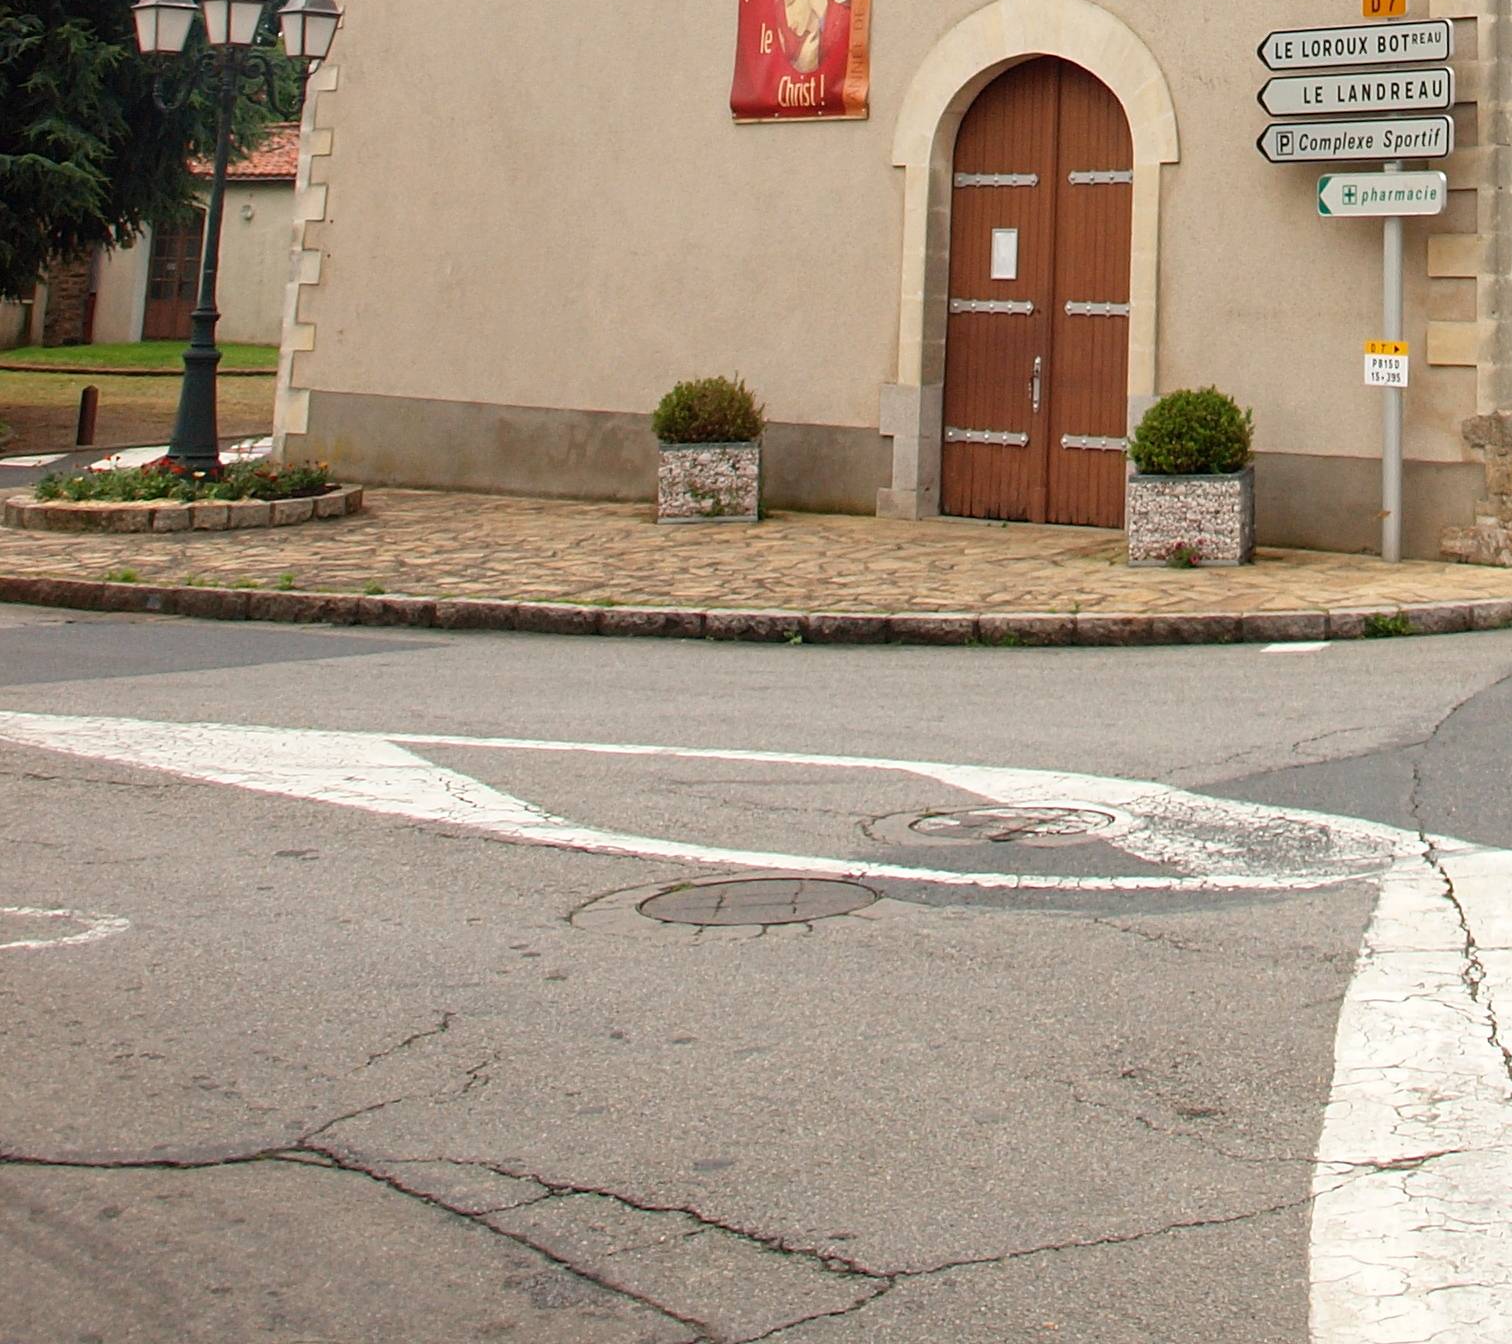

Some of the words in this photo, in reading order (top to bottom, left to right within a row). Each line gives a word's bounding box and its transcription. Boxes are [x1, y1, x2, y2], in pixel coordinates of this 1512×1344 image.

[760, 23, 773, 54] le
[1275, 41, 1293, 59] LE
[1302, 36, 1368, 58] LOROUX
[778, 74, 816, 107] Christ
[1303, 86, 1323, 104] LE
[1337, 79, 1442, 103] LANDREAU
[1299, 132, 1374, 154] Complexe
[1383, 128, 1442, 153] Sportif
[1361, 185, 1437, 206] pharmacie
